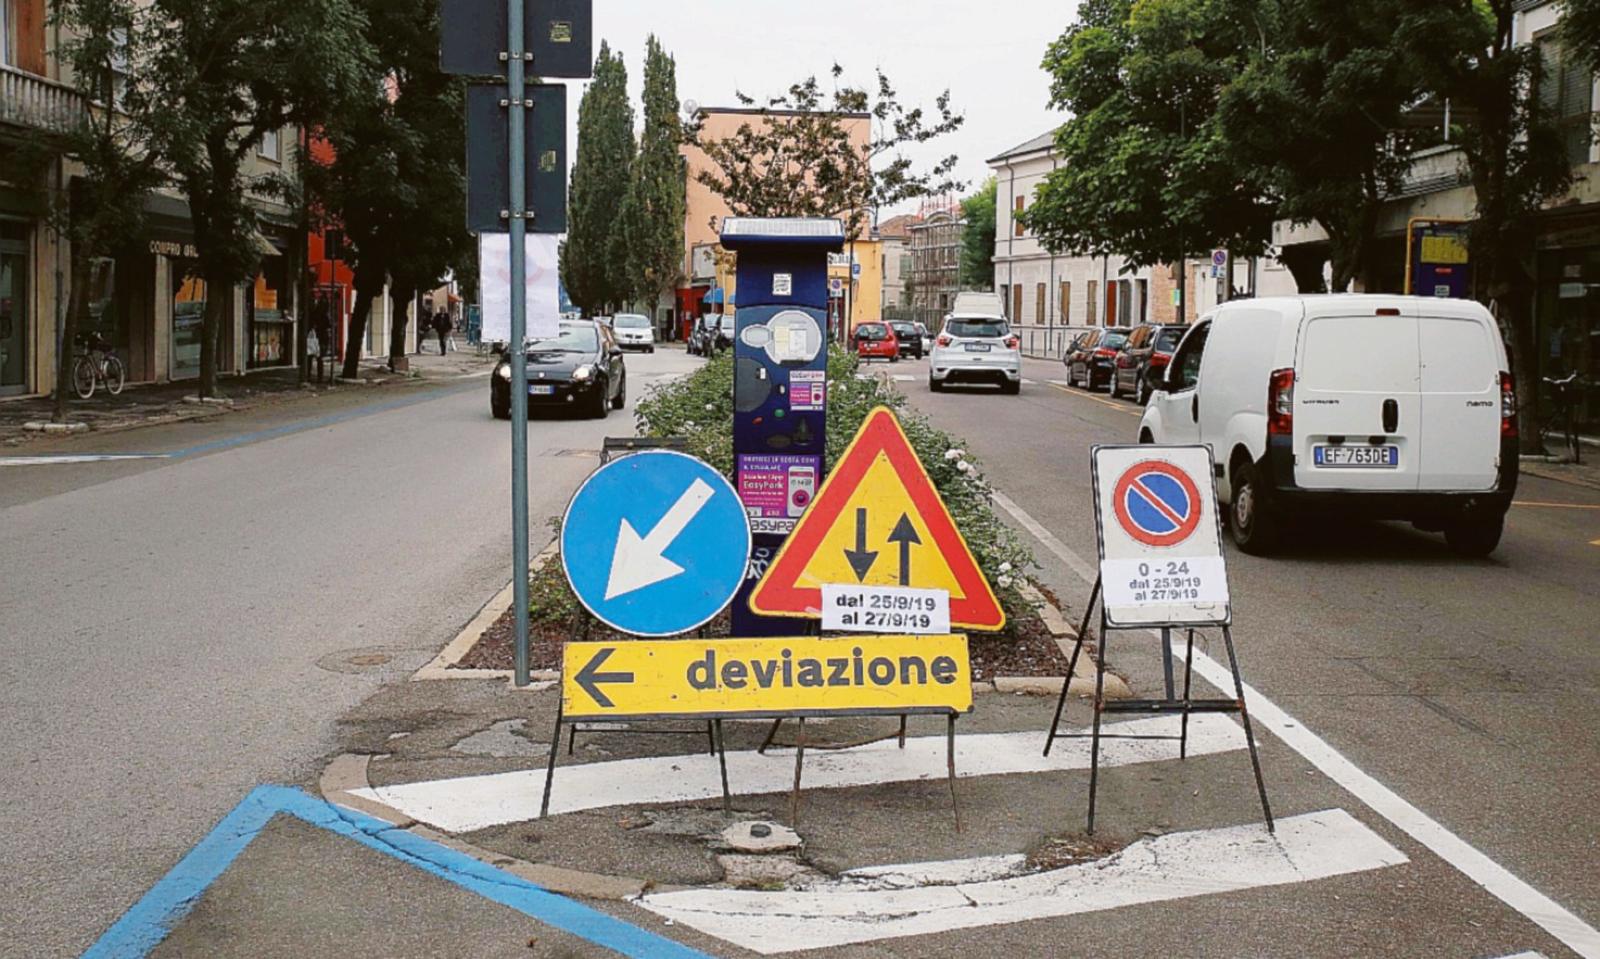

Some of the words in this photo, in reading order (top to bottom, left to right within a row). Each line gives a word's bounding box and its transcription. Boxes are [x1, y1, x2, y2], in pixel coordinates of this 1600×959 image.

[743, 481, 784, 490] EasyPark
[751, 520, 795, 532] asypa
[1167, 561, 1190, 575] 24
[1129, 579, 1150, 590] dal
[1153, 577, 1202, 590] 25/9/19
[1134, 591, 1147, 601] al
[1151, 588, 1199, 601] 27/9/19
[836, 594, 864, 608] dal
[870, 594, 937, 612] 25/9/19
[841, 611, 859, 625] al
[864, 611, 931, 629] 27/9/19
[686, 646, 958, 690] deviazione
